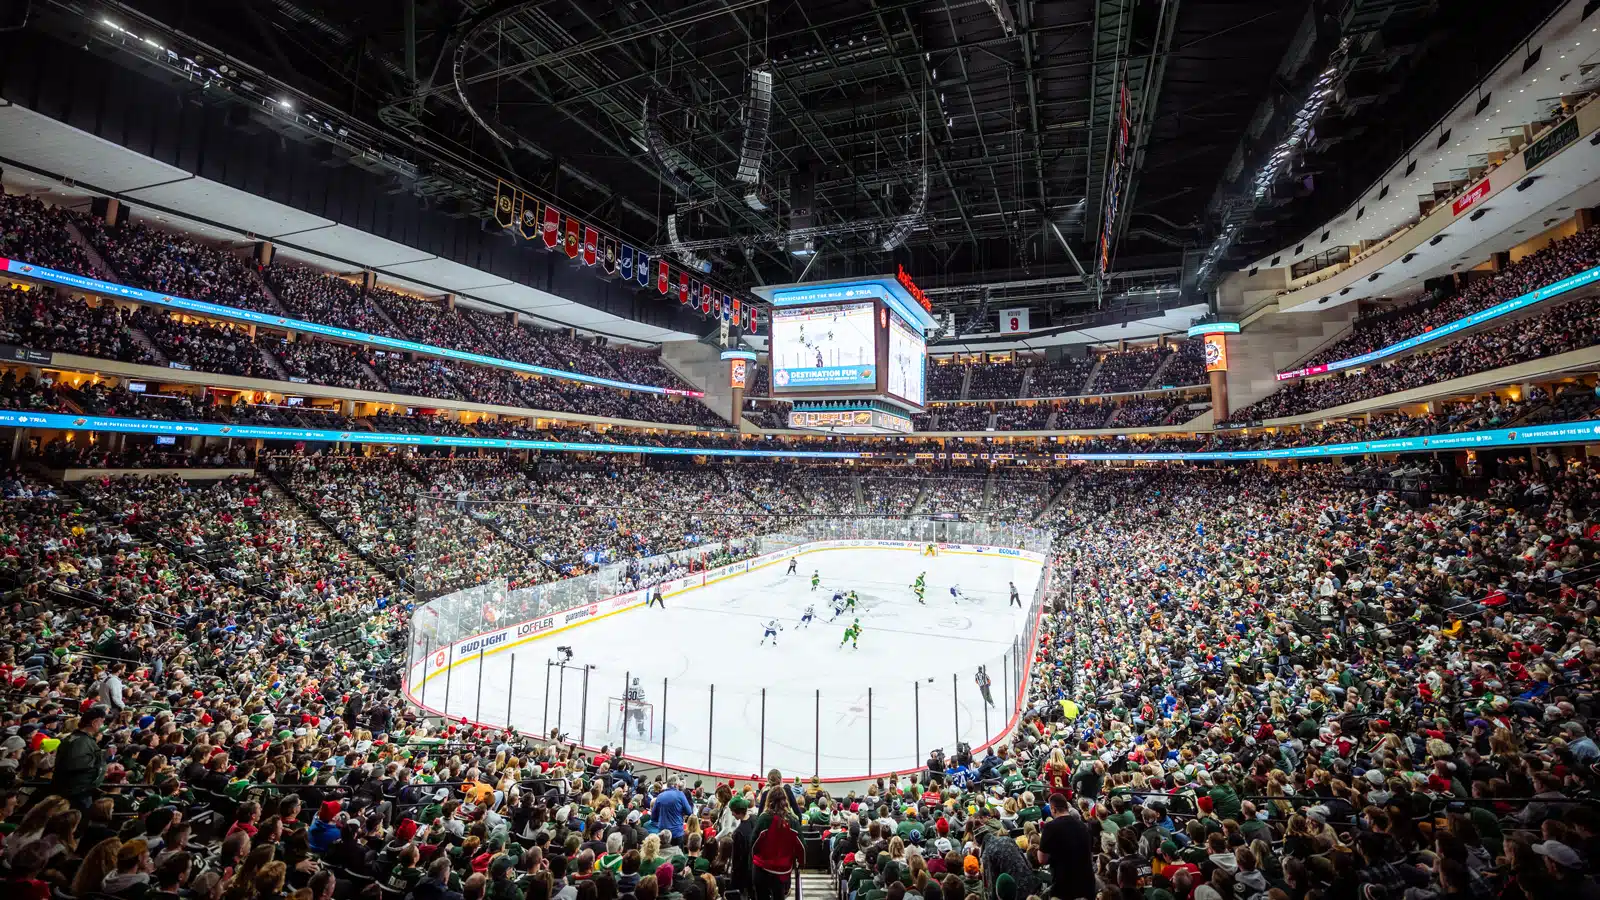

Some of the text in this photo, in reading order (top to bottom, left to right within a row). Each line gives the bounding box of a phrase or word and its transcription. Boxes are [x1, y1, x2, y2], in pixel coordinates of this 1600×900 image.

[40, 270, 55, 279] TEAM
[55, 273, 86, 285] PHYSICIANS
[129, 289, 144, 297] TRIA
[1010, 317, 1019, 331] 9
[790, 369, 858, 379] DESTINATION FUN
[998, 548, 1020, 556] ECOLAB
[565, 606, 590, 624] guaranteed
[517, 617, 554, 636] LOFFLER
[460, 632, 508, 655] BUD LIGHT
[628, 690, 638, 701] 30
